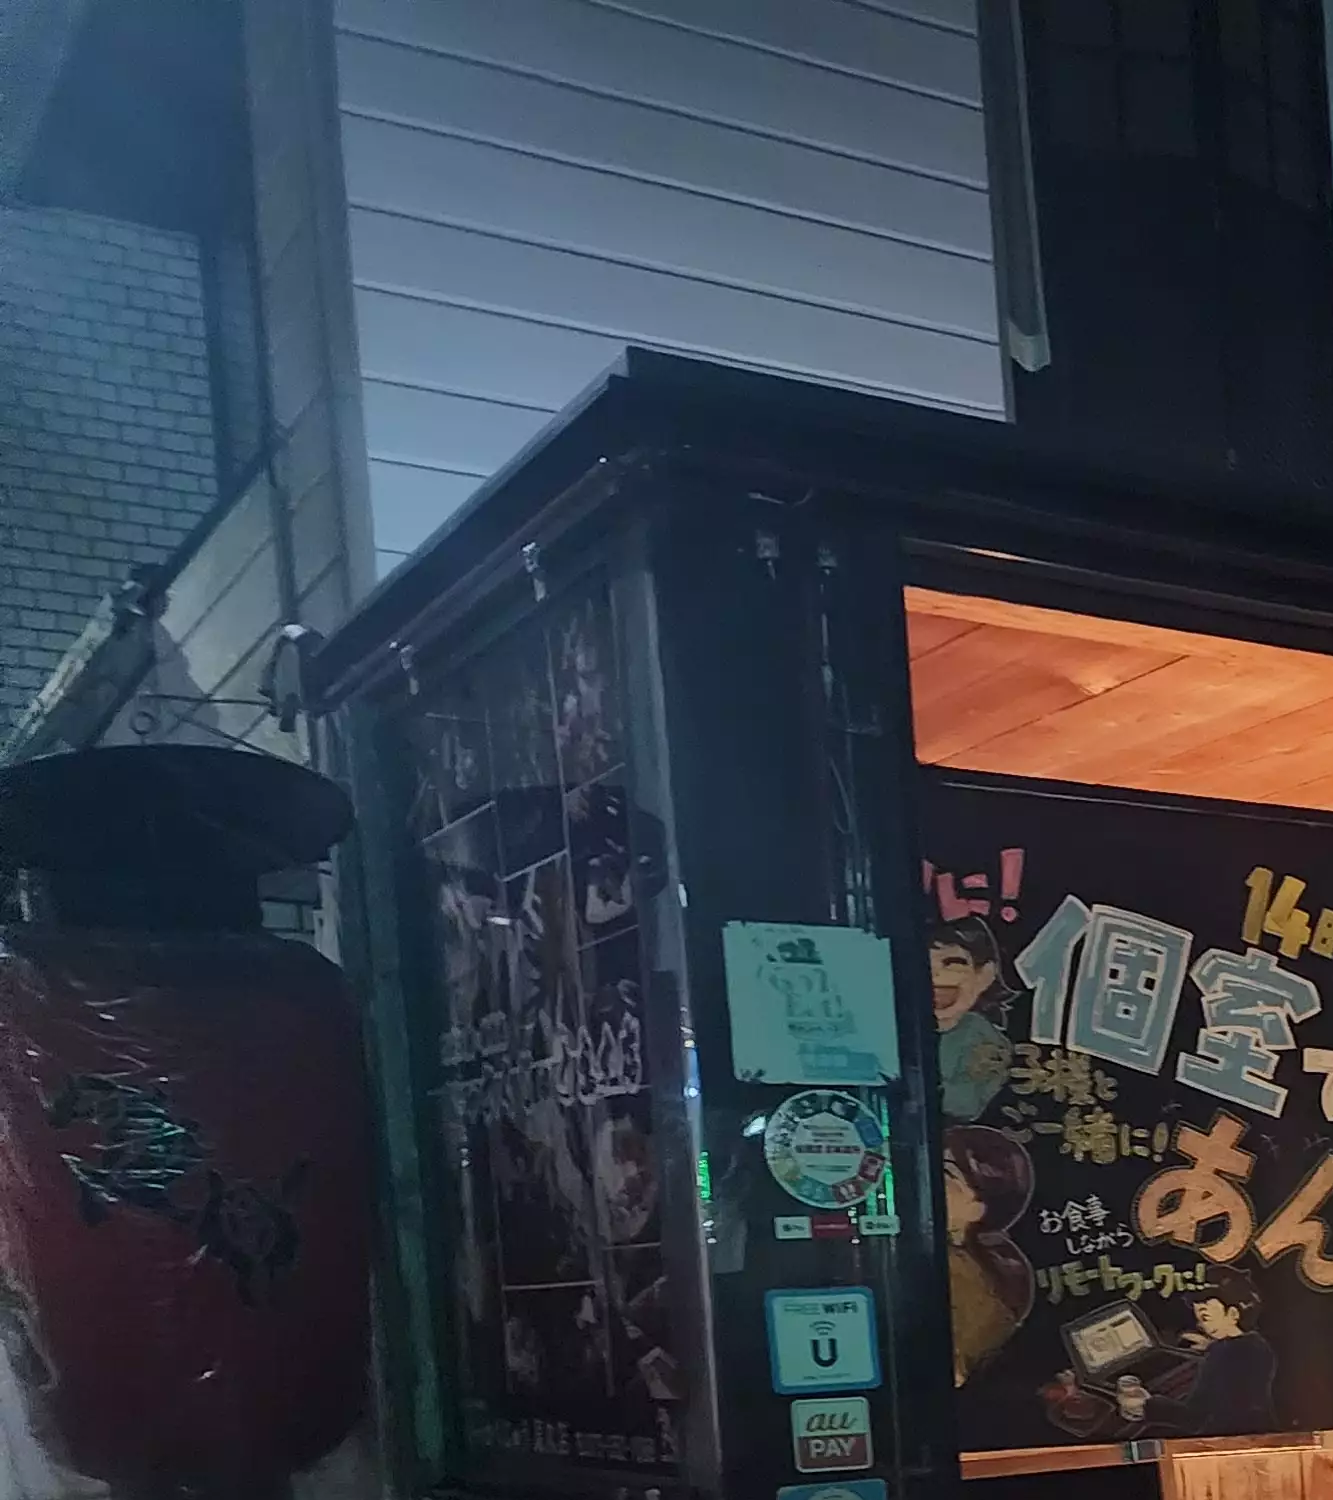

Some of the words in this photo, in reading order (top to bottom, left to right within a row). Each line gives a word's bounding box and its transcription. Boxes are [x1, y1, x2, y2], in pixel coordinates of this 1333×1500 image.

[1039, 1194, 1111, 1234] お食事
[1064, 1222, 1135, 1255] しながら
[805, 1411, 858, 1433] au
[808, 1437, 857, 1459] PAY
